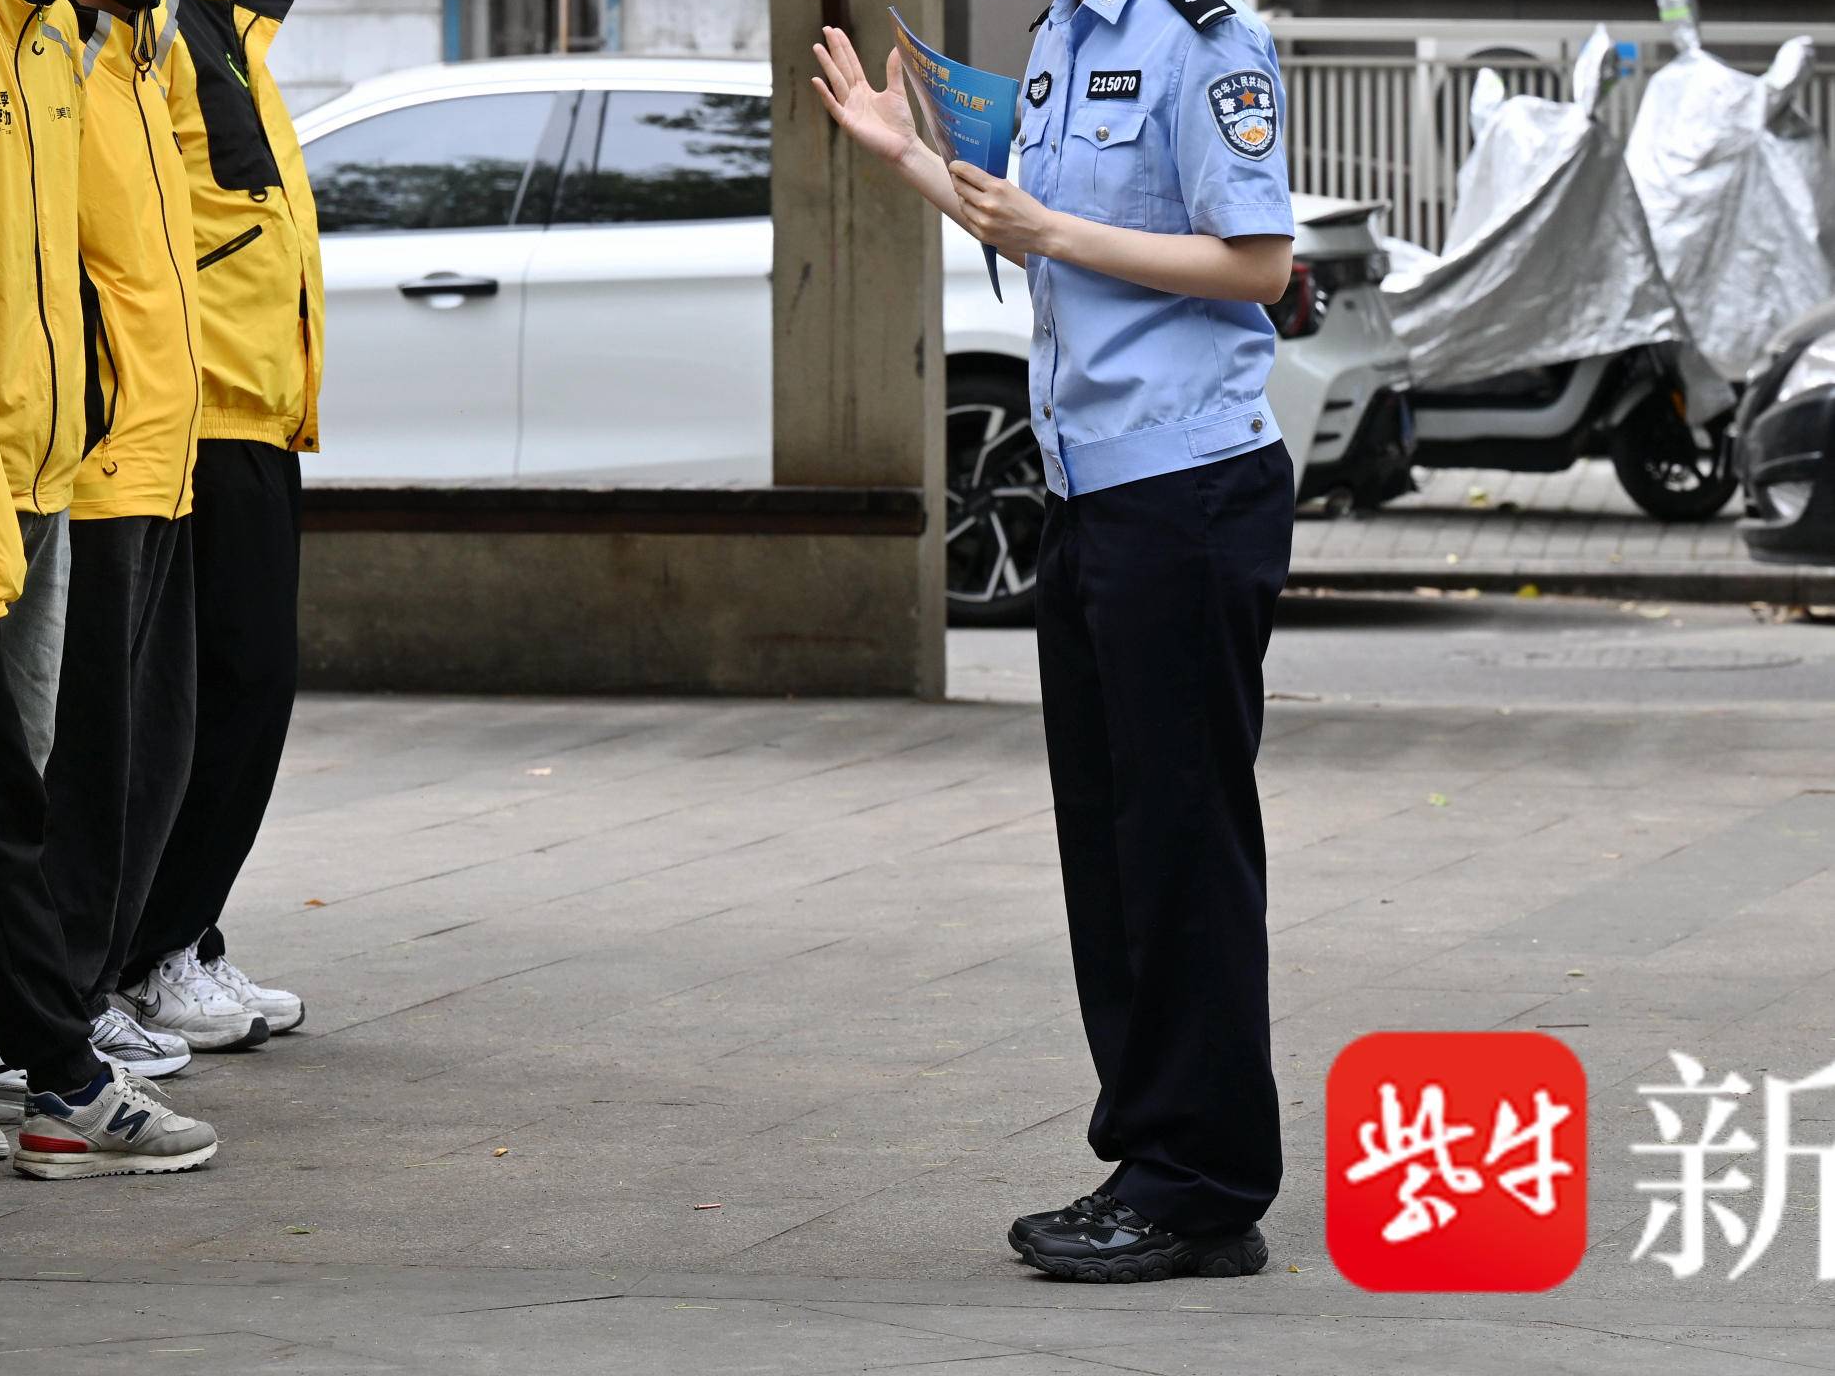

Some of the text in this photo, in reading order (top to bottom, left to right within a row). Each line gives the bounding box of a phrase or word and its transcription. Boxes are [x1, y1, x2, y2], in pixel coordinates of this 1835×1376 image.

[1090, 75, 1137, 92] 215070
[1212, 75, 1270, 100] 中华人民共和国
